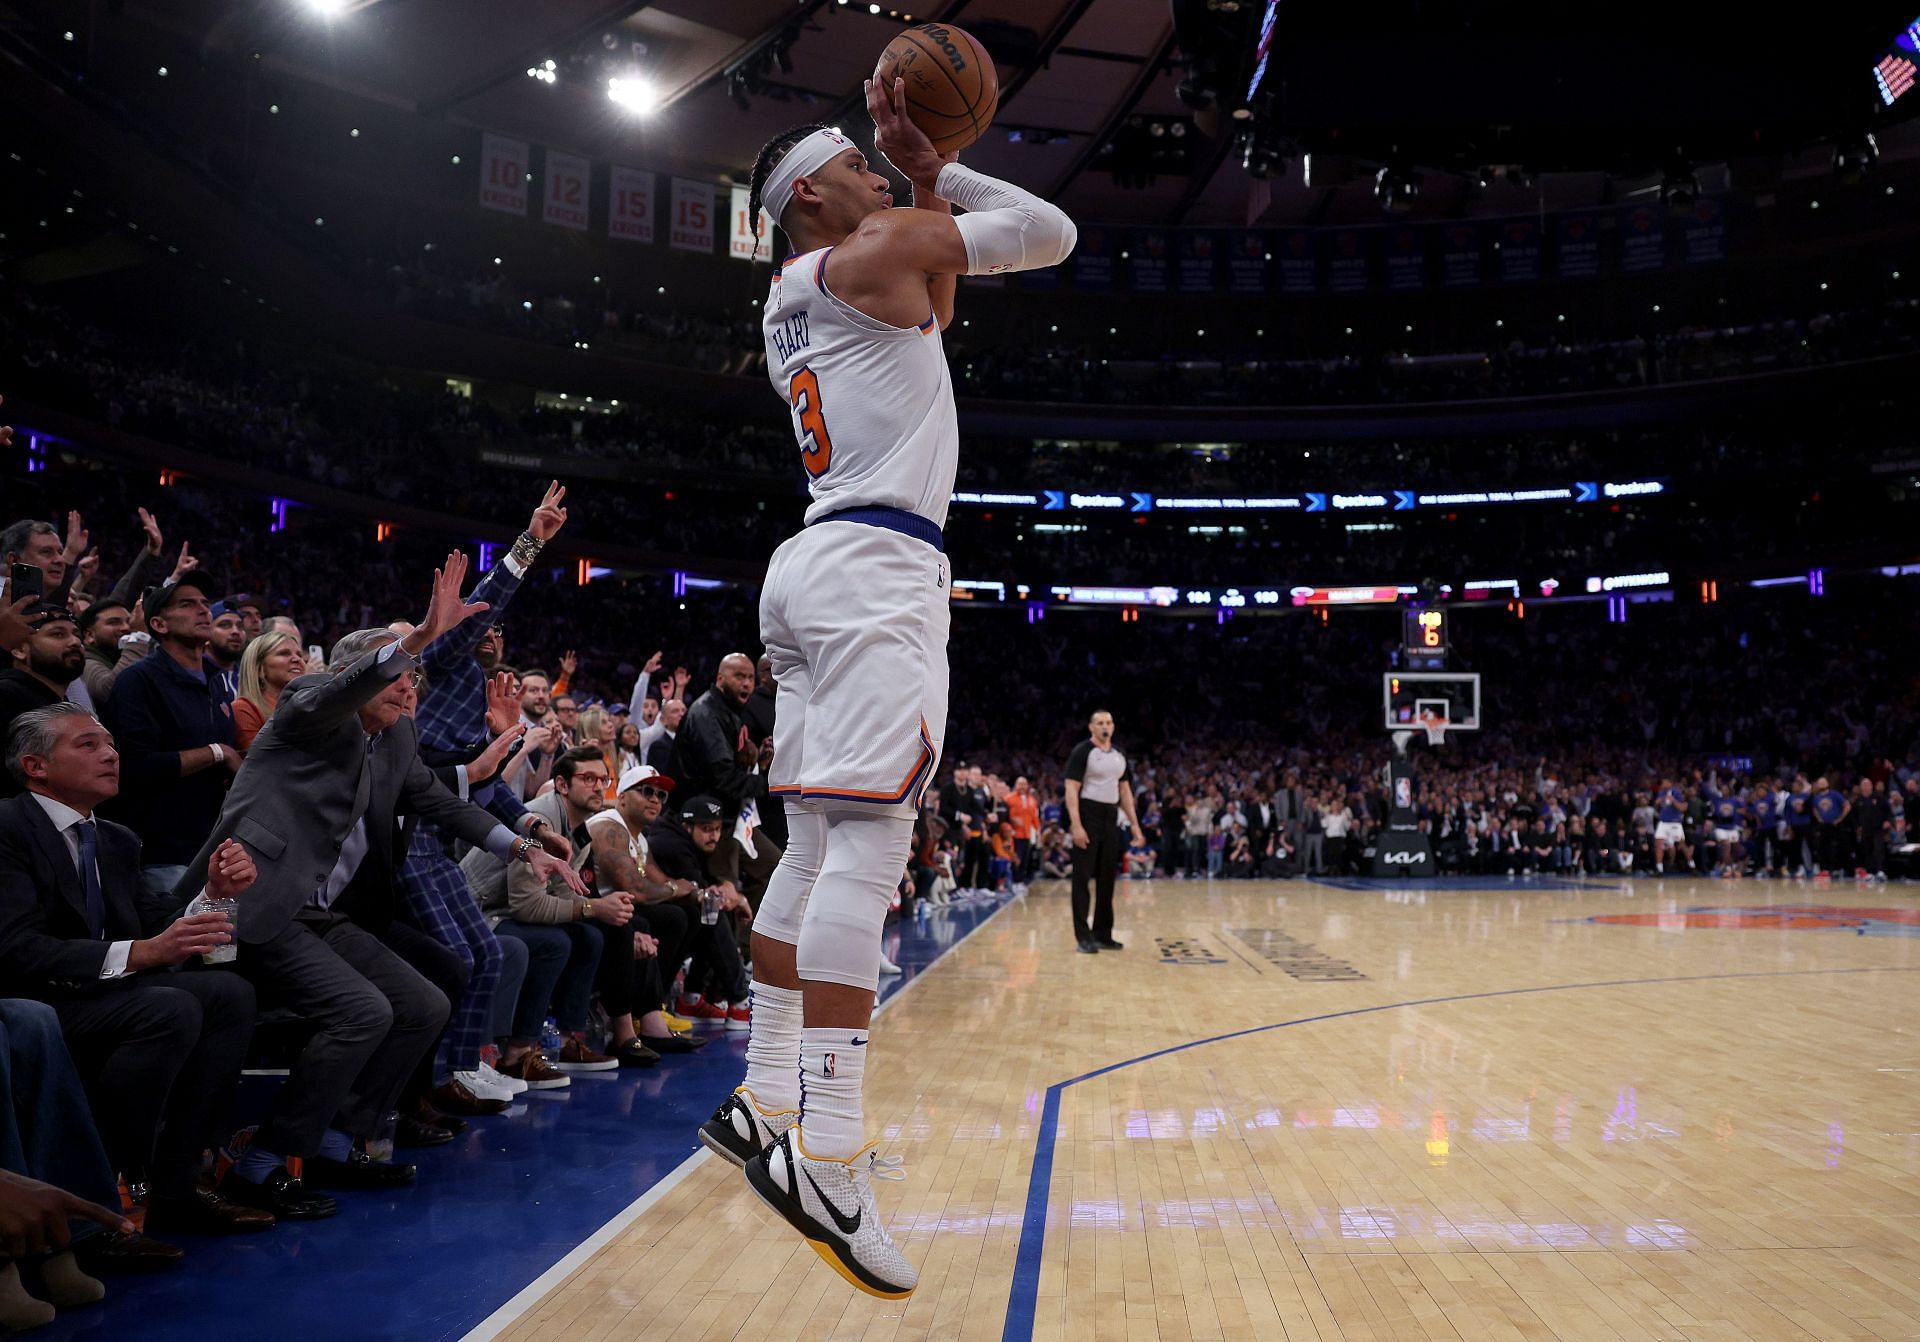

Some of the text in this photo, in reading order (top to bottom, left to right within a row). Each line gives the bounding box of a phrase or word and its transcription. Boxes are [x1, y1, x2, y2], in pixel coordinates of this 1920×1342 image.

[489, 159, 520, 189] 10
[552, 175, 581, 204] 12
[617, 190, 646, 218] 15
[679, 201, 707, 229] 15
[772, 310, 811, 366] HART
[790, 365, 833, 479] 3
[1332, 494, 1385, 508] Spectrum
[1604, 482, 1660, 498] Spectrum
[1425, 624, 1439, 646] 6
